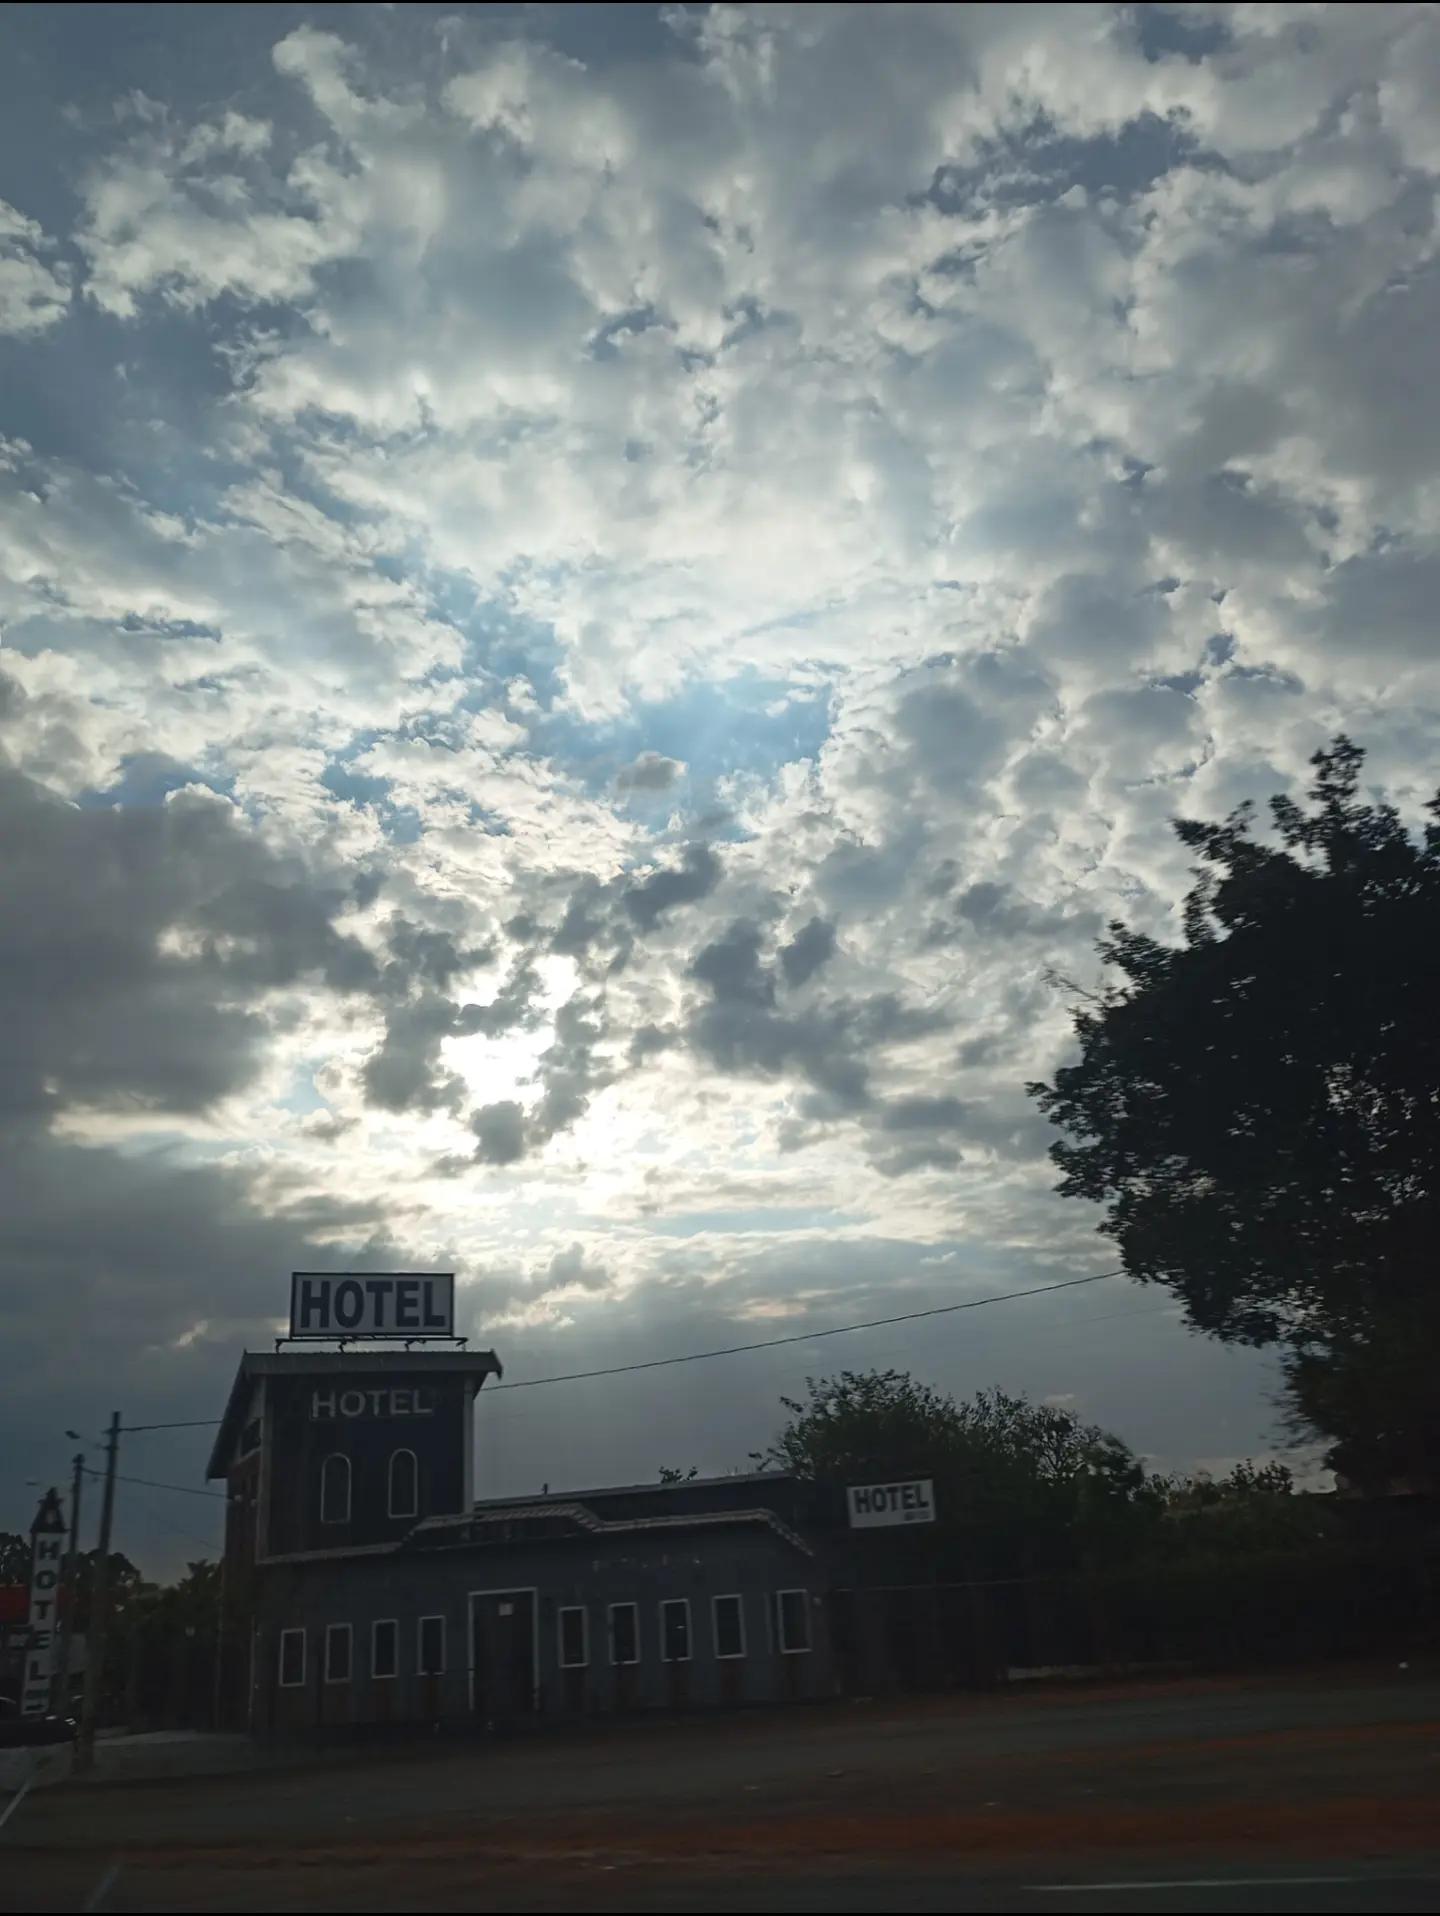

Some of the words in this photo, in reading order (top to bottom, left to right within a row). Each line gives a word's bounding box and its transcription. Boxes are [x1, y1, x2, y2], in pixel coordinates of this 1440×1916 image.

[301, 1280, 446, 1328] HOTEL
[312, 1389, 432, 1418] HOTEL
[853, 1484, 929, 1513] HOTEL
[29, 1539, 59, 1681] HOTEL
